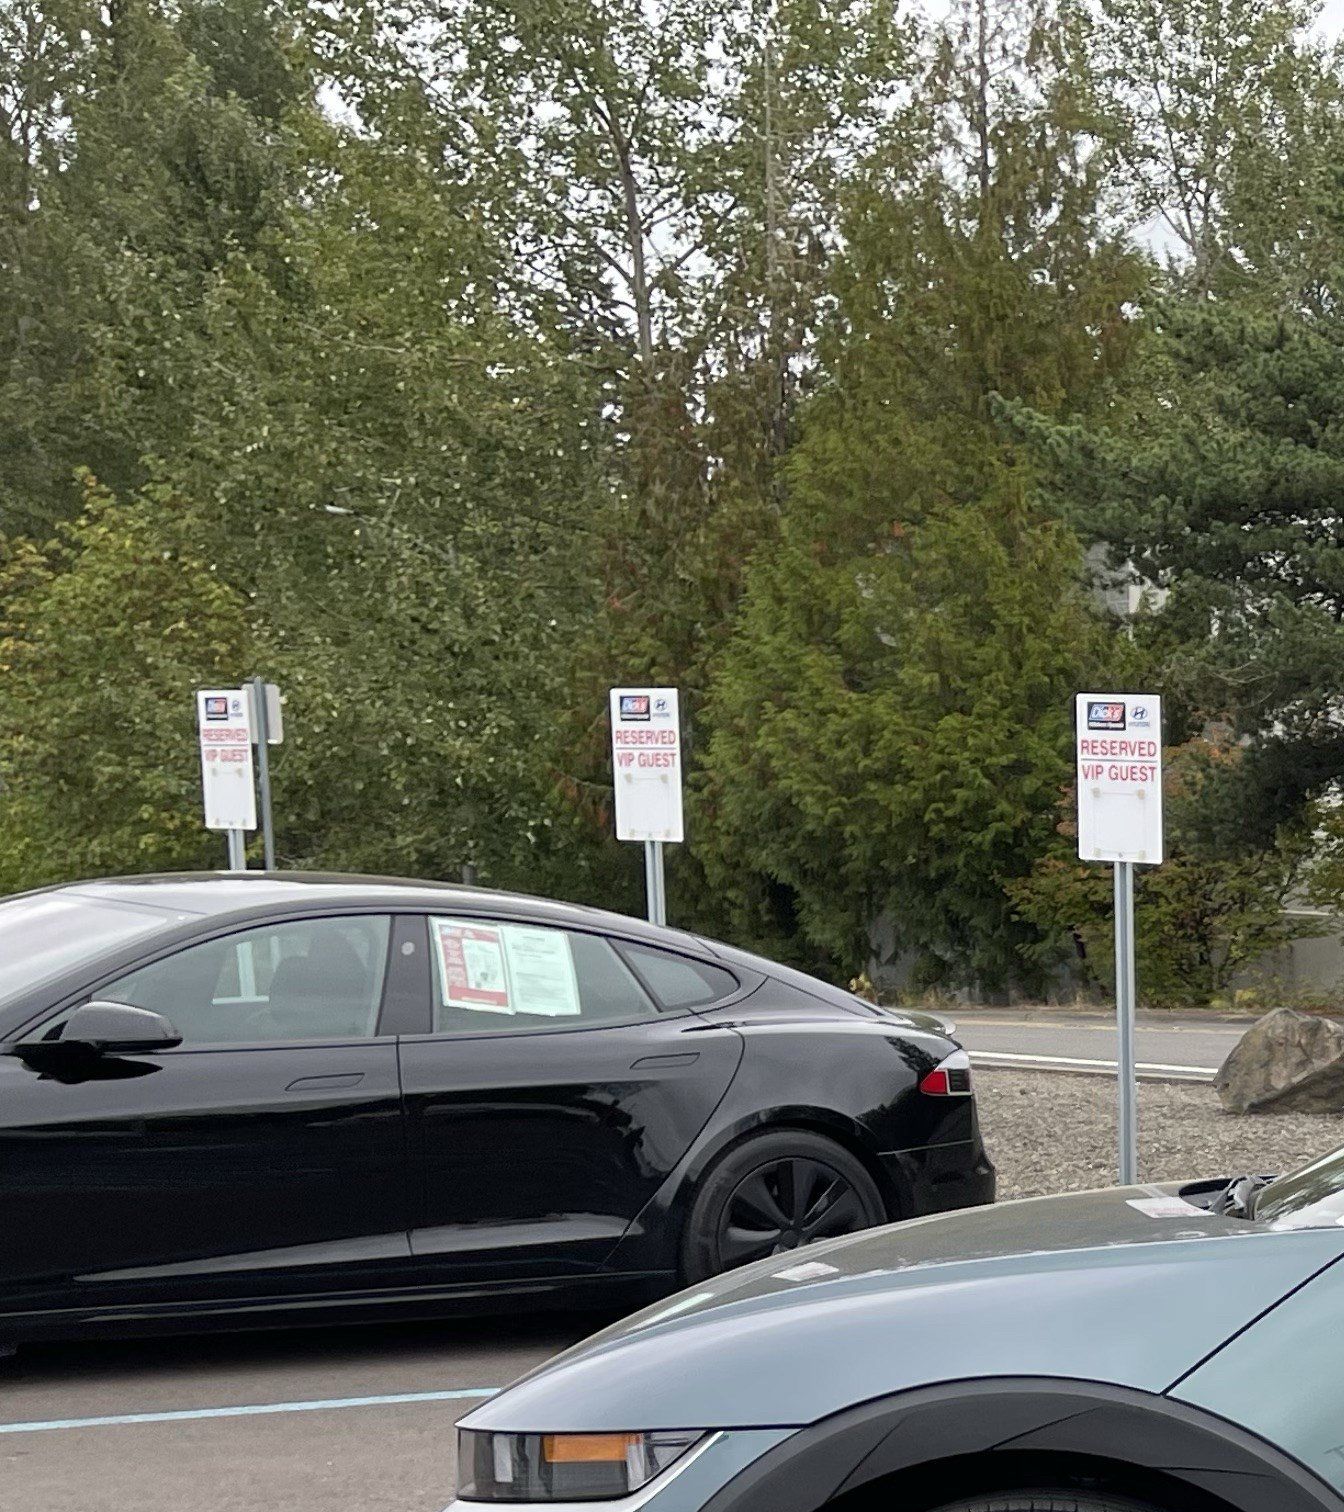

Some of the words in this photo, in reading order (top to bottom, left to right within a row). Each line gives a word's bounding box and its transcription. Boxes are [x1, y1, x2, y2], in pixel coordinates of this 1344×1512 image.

[615, 730, 676, 745] RESERVED
[1080, 739, 1157, 757] RESERVED
[617, 752, 635, 767] VIP
[638, 752, 676, 768] GUEST
[1081, 764, 1104, 780] VIP
[1108, 765, 1157, 782] GUEST
